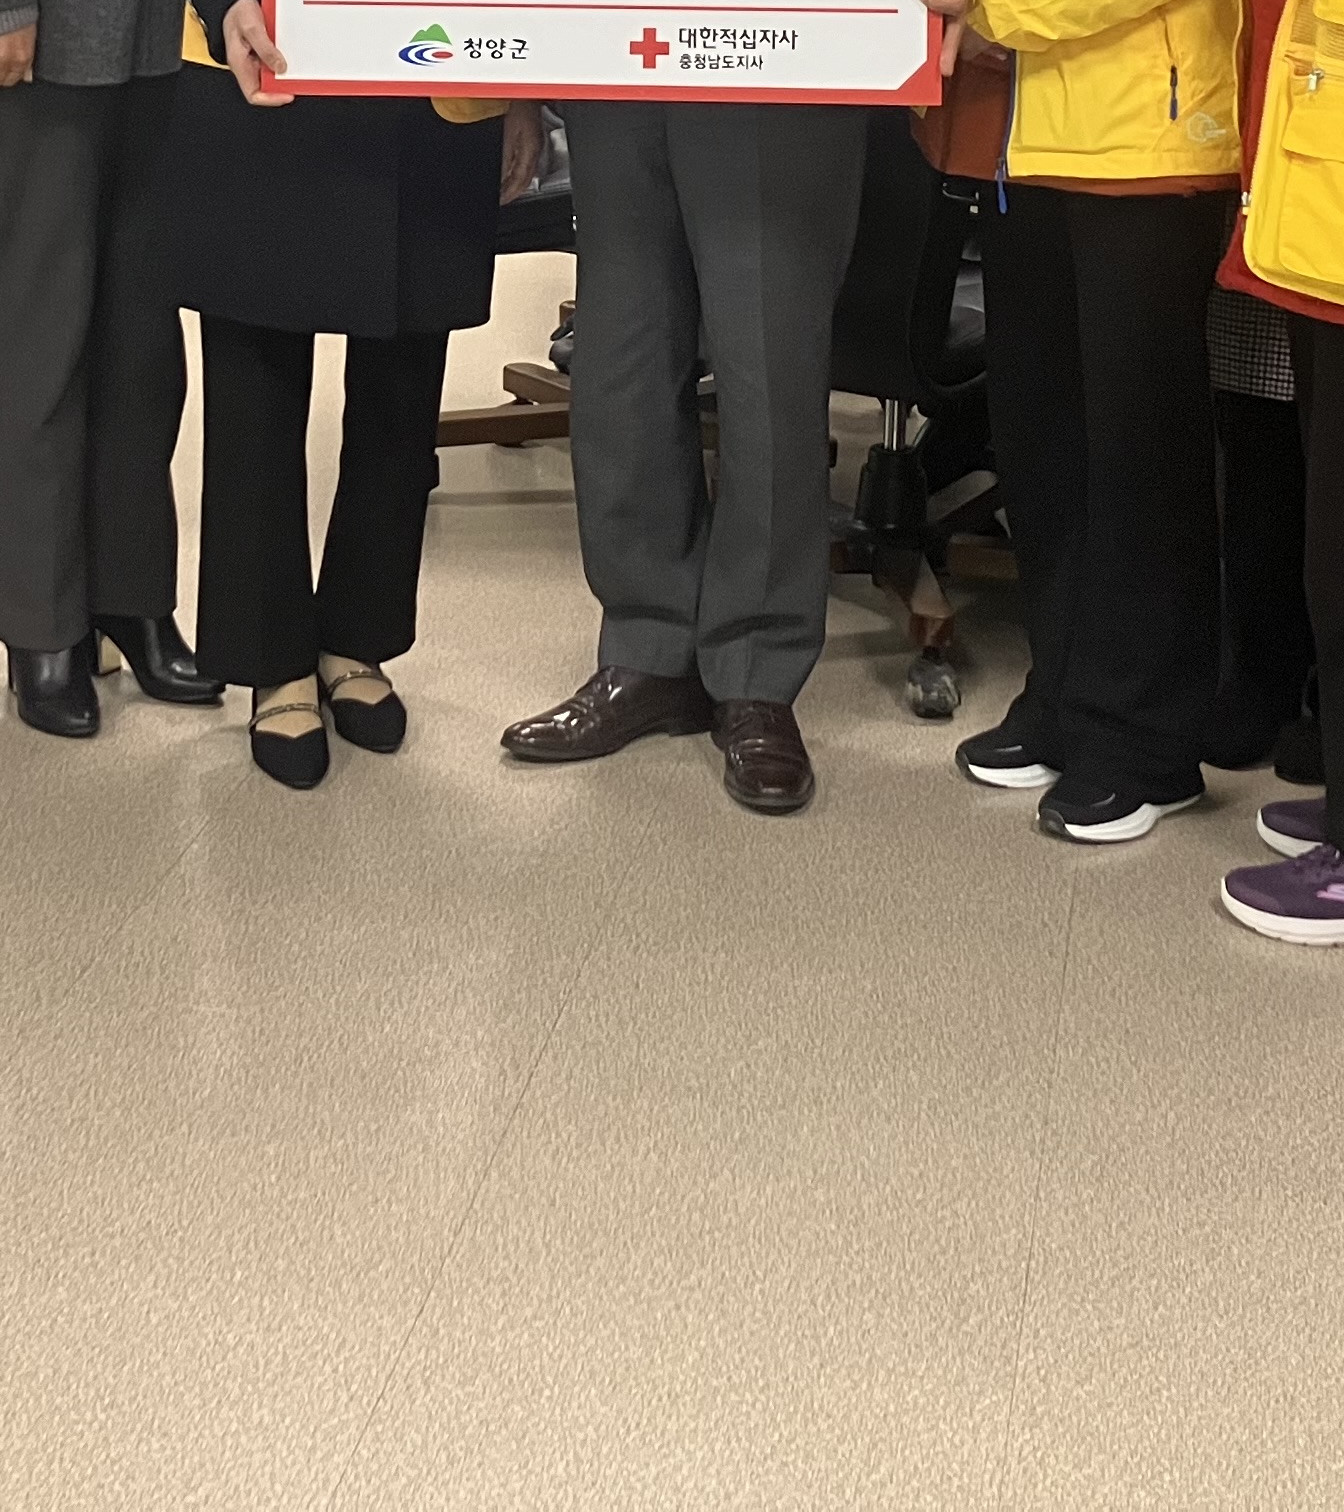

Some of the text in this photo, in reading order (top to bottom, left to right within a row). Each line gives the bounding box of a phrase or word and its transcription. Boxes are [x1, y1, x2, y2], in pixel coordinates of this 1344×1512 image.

[463, 37, 530, 61] 청양군
[678, 26, 799, 51] 대한적십자사
[679, 53, 764, 71] 충청남도지사
